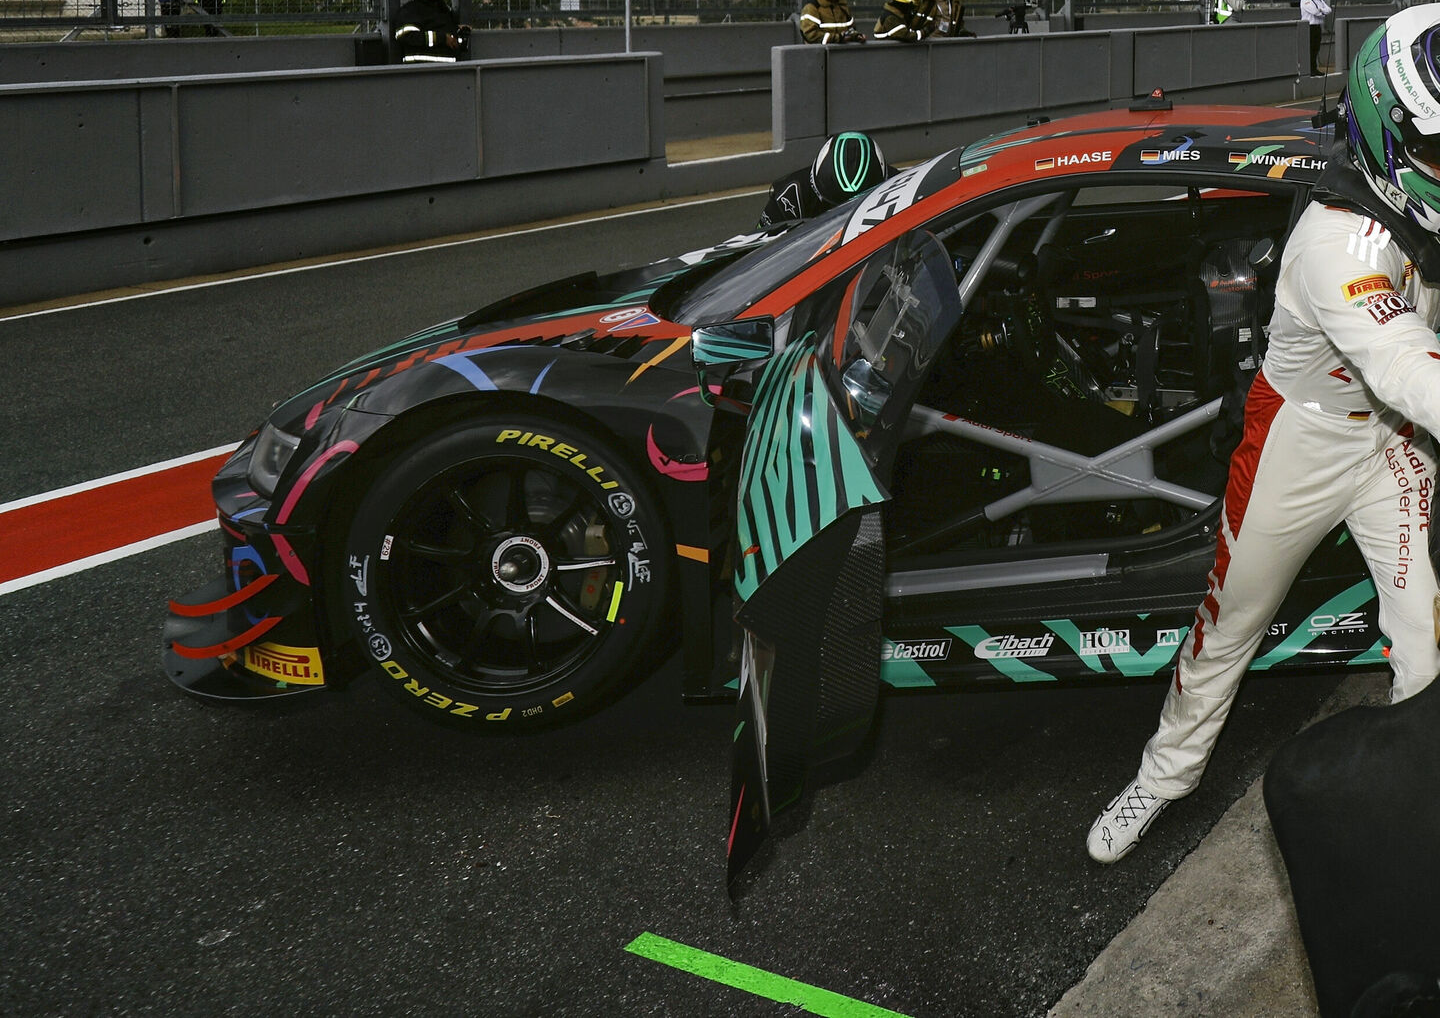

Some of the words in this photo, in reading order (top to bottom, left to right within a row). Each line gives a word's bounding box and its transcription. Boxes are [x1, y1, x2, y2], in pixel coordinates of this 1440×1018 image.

[1394, 58, 1438, 119] MONTAPLAST
[1057, 150, 1112, 167] HAASE
[1162, 150, 1201, 161] MIES
[496, 429, 619, 491] PIRELLI
[1418, 477, 1433, 532] Sport
[381, 538, 392, 557] #29
[519, 537, 542, 550] FRONT
[1393, 523, 1413, 590] racing
[525, 574, 545, 590] FRONT
[1081, 627, 1129, 649] HÖR
[1311, 628, 1365, 636] RACING
[893, 640, 945, 660] Castrol
[974, 632, 1056, 660] Eibach
[380, 660, 480, 719] ZERO
[486, 707, 513, 721] P
[521, 705, 543, 719] DHD2
